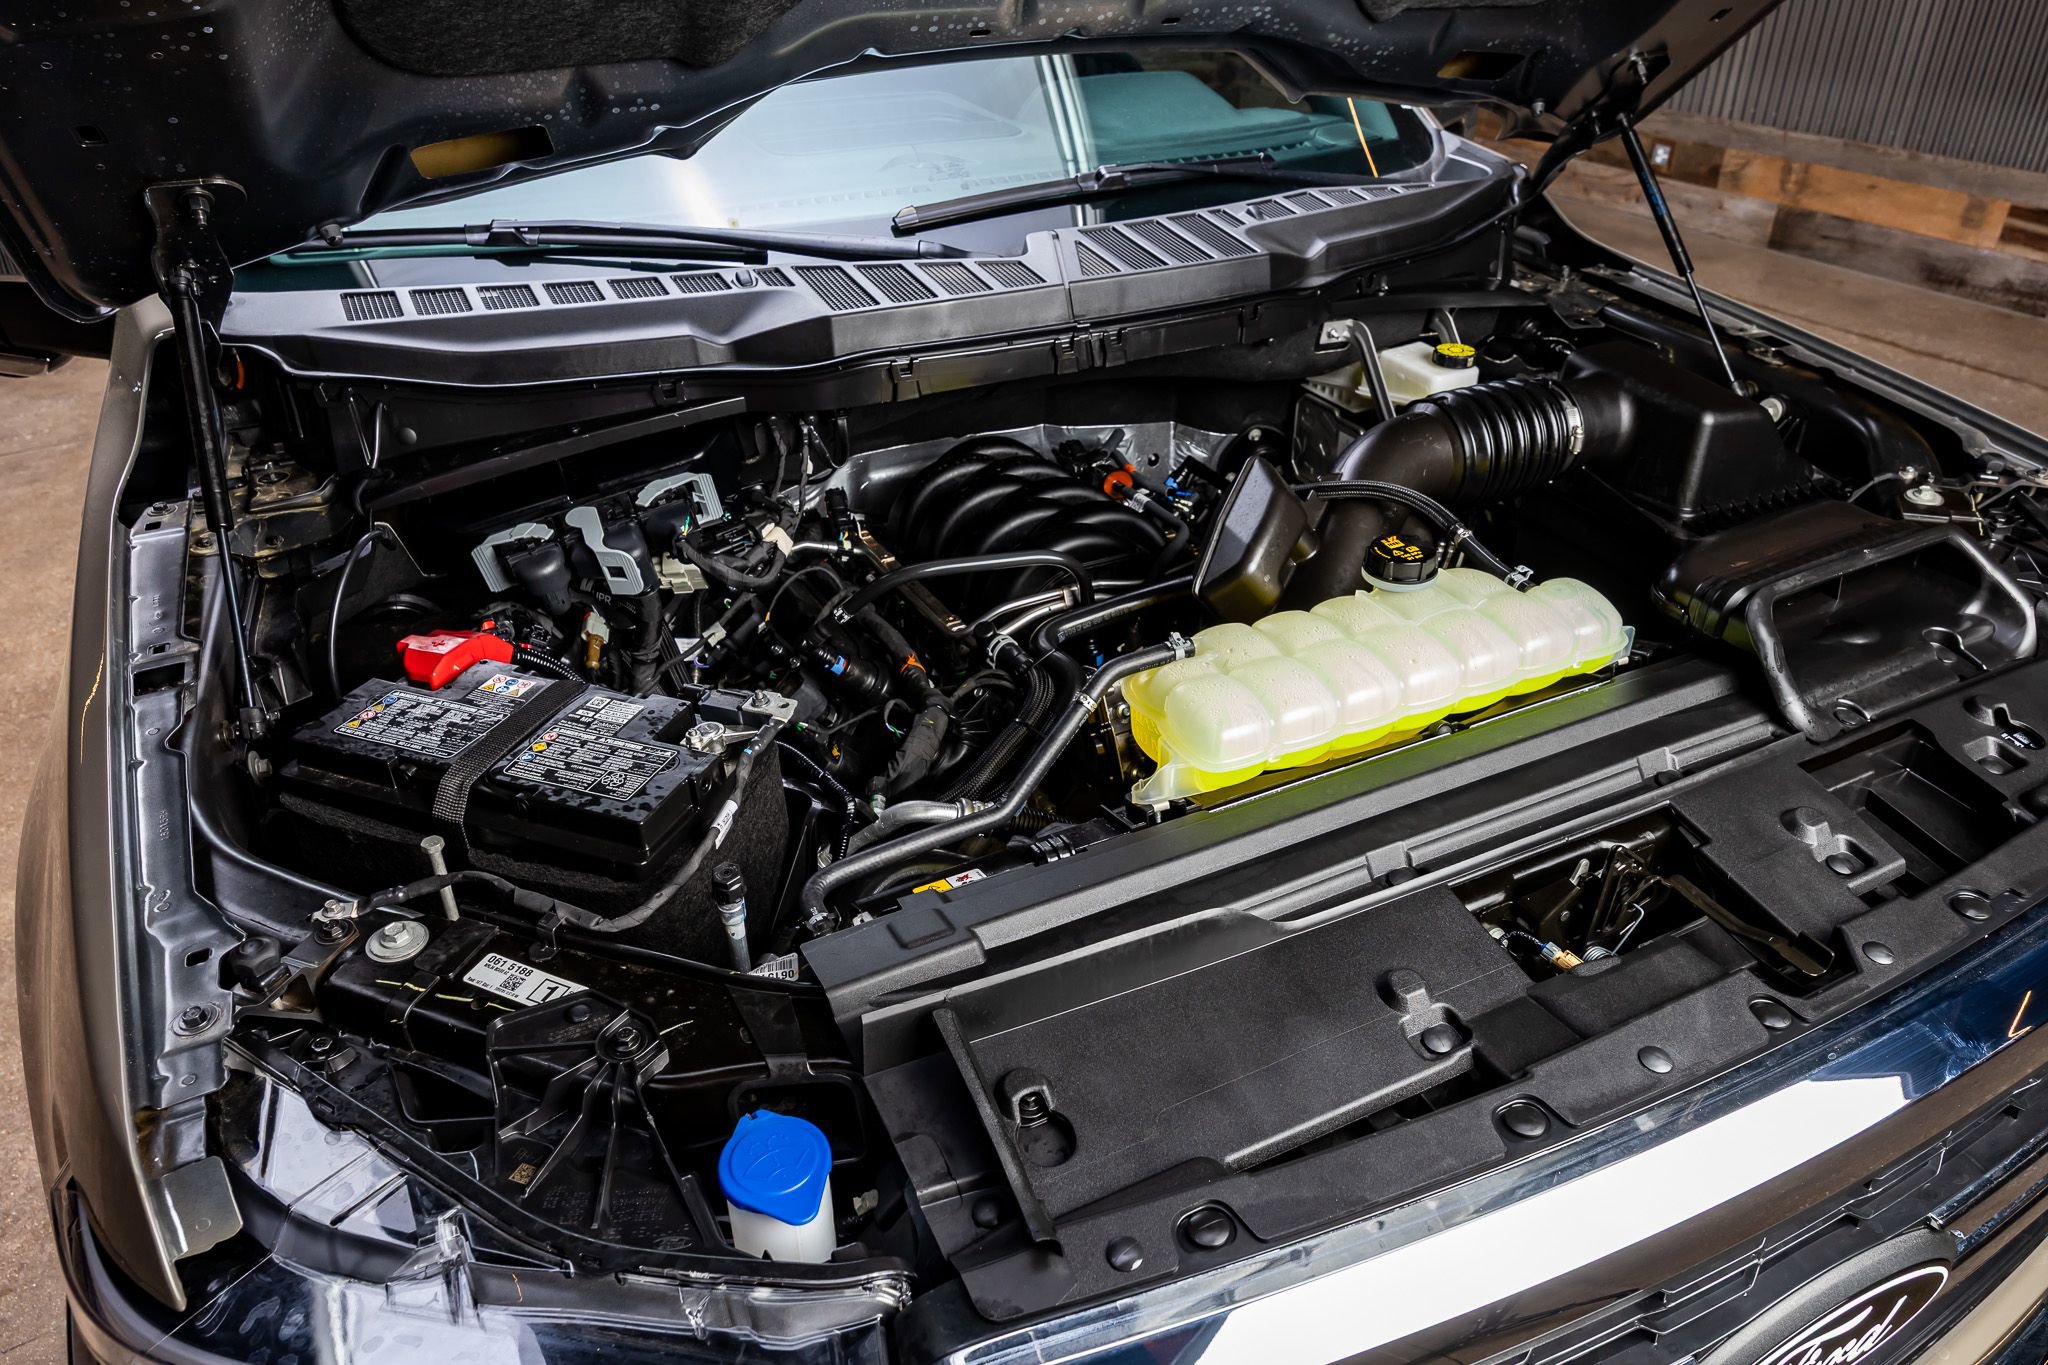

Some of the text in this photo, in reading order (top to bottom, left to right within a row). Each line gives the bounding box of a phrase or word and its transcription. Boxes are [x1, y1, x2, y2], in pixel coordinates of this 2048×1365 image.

[487, 955, 505, 968] 061
[507, 963, 533, 977] 5188
[540, 985, 559, 1003] 1
